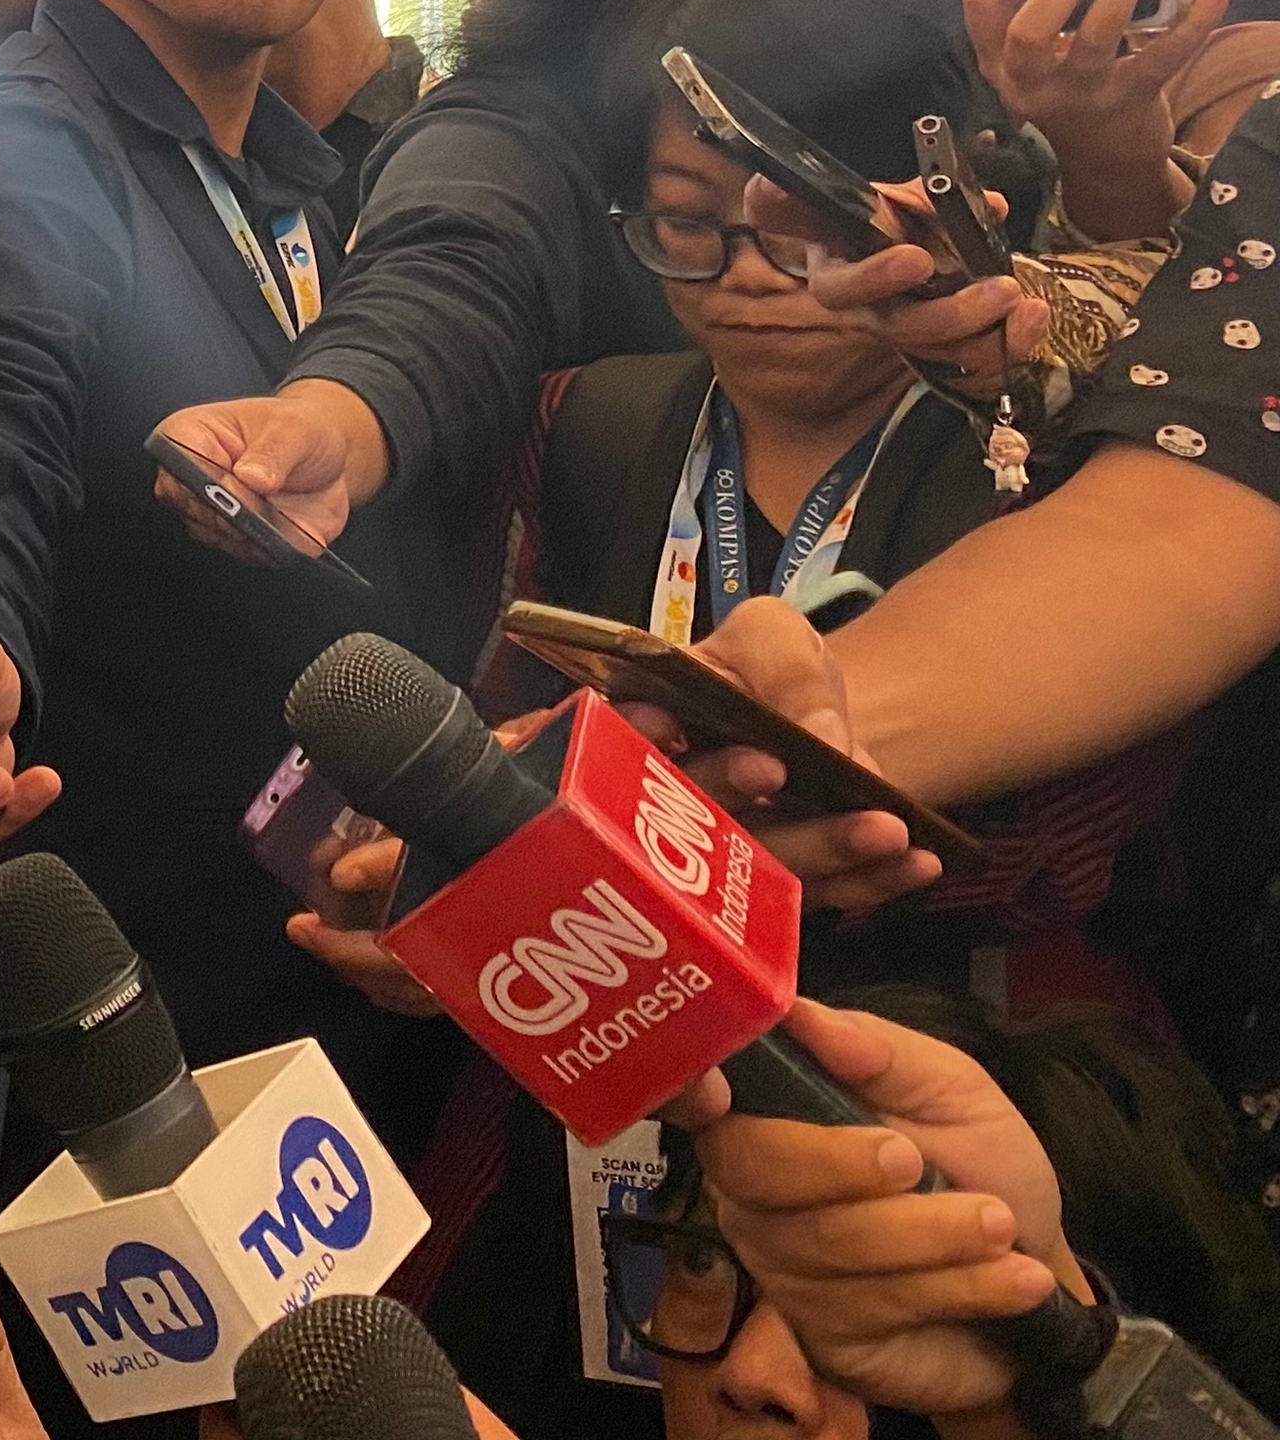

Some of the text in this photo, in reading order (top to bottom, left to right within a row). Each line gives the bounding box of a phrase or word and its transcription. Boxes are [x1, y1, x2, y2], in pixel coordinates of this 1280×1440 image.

[716, 491, 740, 579] KOMPAS
[634, 754, 717, 897] CNN
[713, 831, 755, 946] Indonesia
[79, 981, 142, 1032] SENNHEISER
[478, 877, 669, 1037] CNN
[541, 960, 713, 1086] Indonesia
[238, 1137, 362, 1281] TVRI
[592, 1171, 636, 1188] EVENT
[601, 1157, 641, 1173] SCAN
[47, 1269, 195, 1347] TVRI
